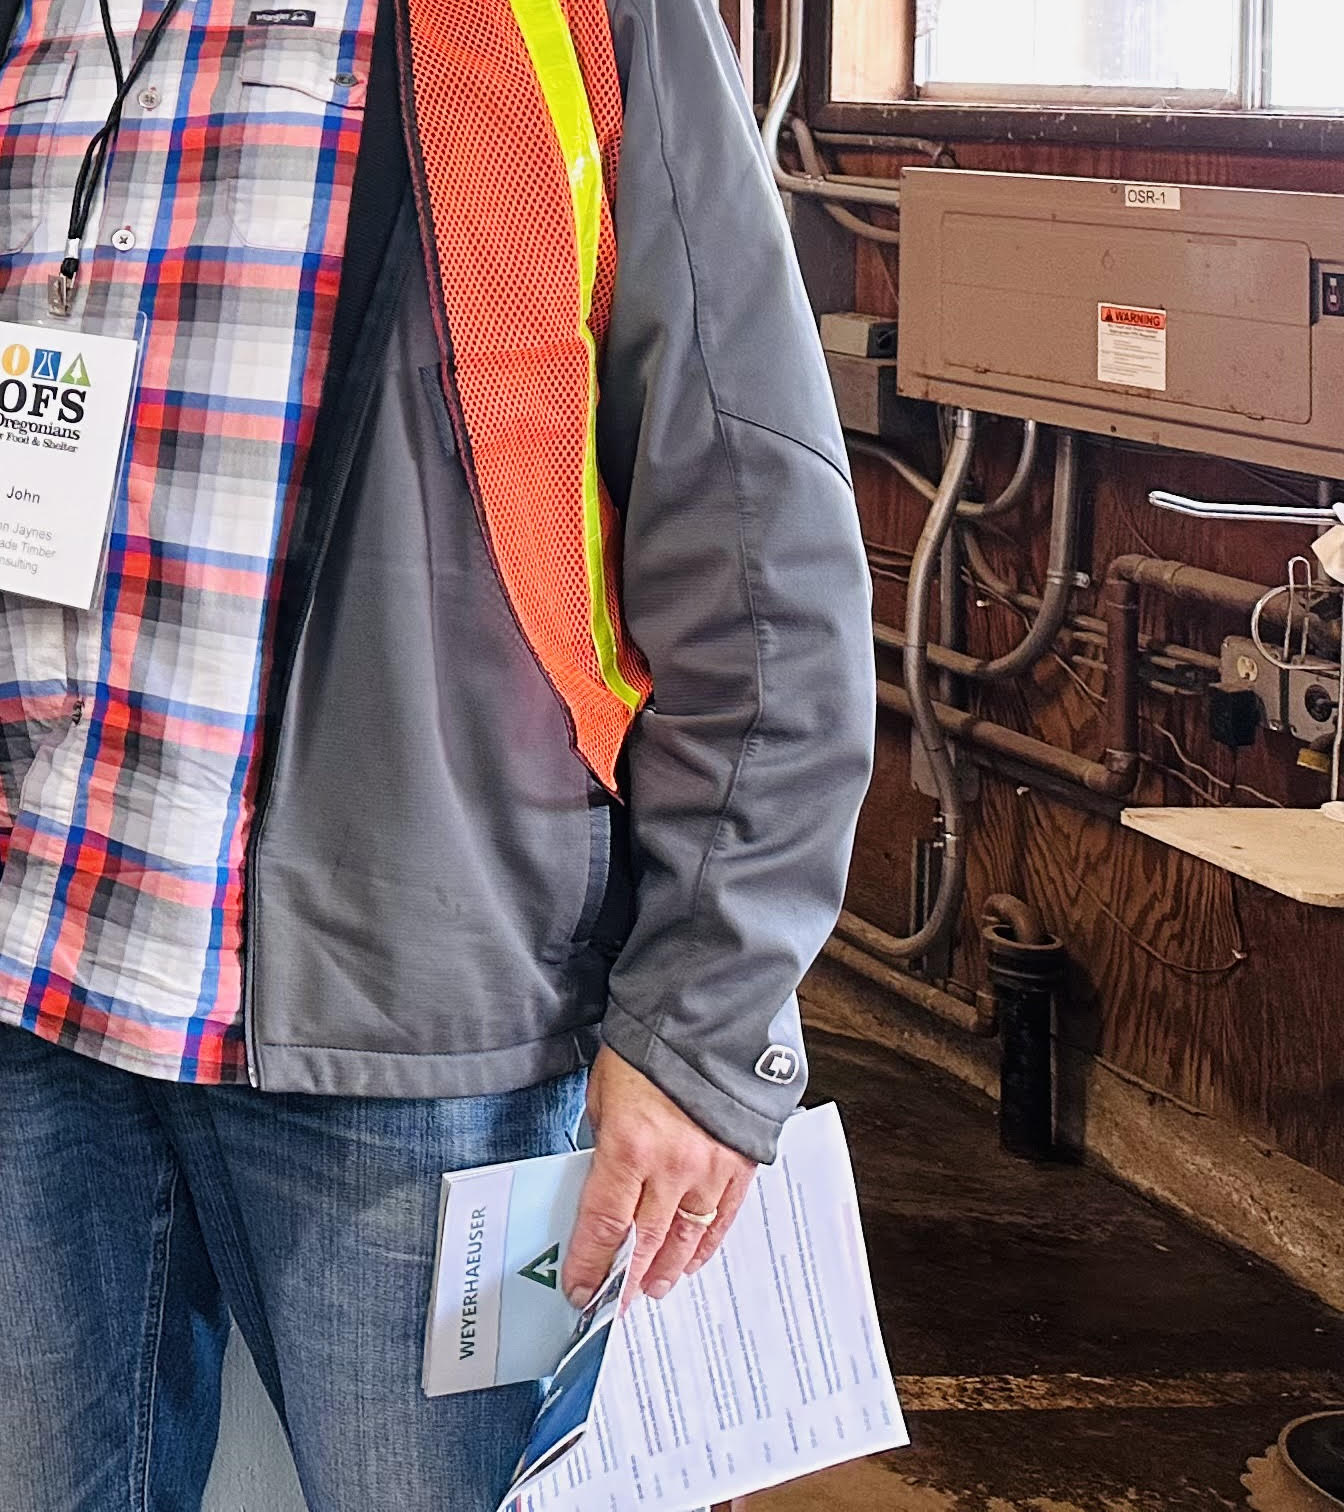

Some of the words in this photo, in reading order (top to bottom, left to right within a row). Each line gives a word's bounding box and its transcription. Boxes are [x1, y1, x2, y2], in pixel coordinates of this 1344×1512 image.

[1128, 189, 1166, 204] OSR-1
[1115, 311, 1161, 327] WARNING
[6, 432, 30, 446] Food
[32, 437, 41, 447] &
[43, 438, 79, 454] Shelter
[6, 485, 41, 504] John
[12, 522, 53, 541] Jaynes
[21, 540, 57, 559] Timber
[459, 1205, 487, 1361] WEYERHAEUSER
